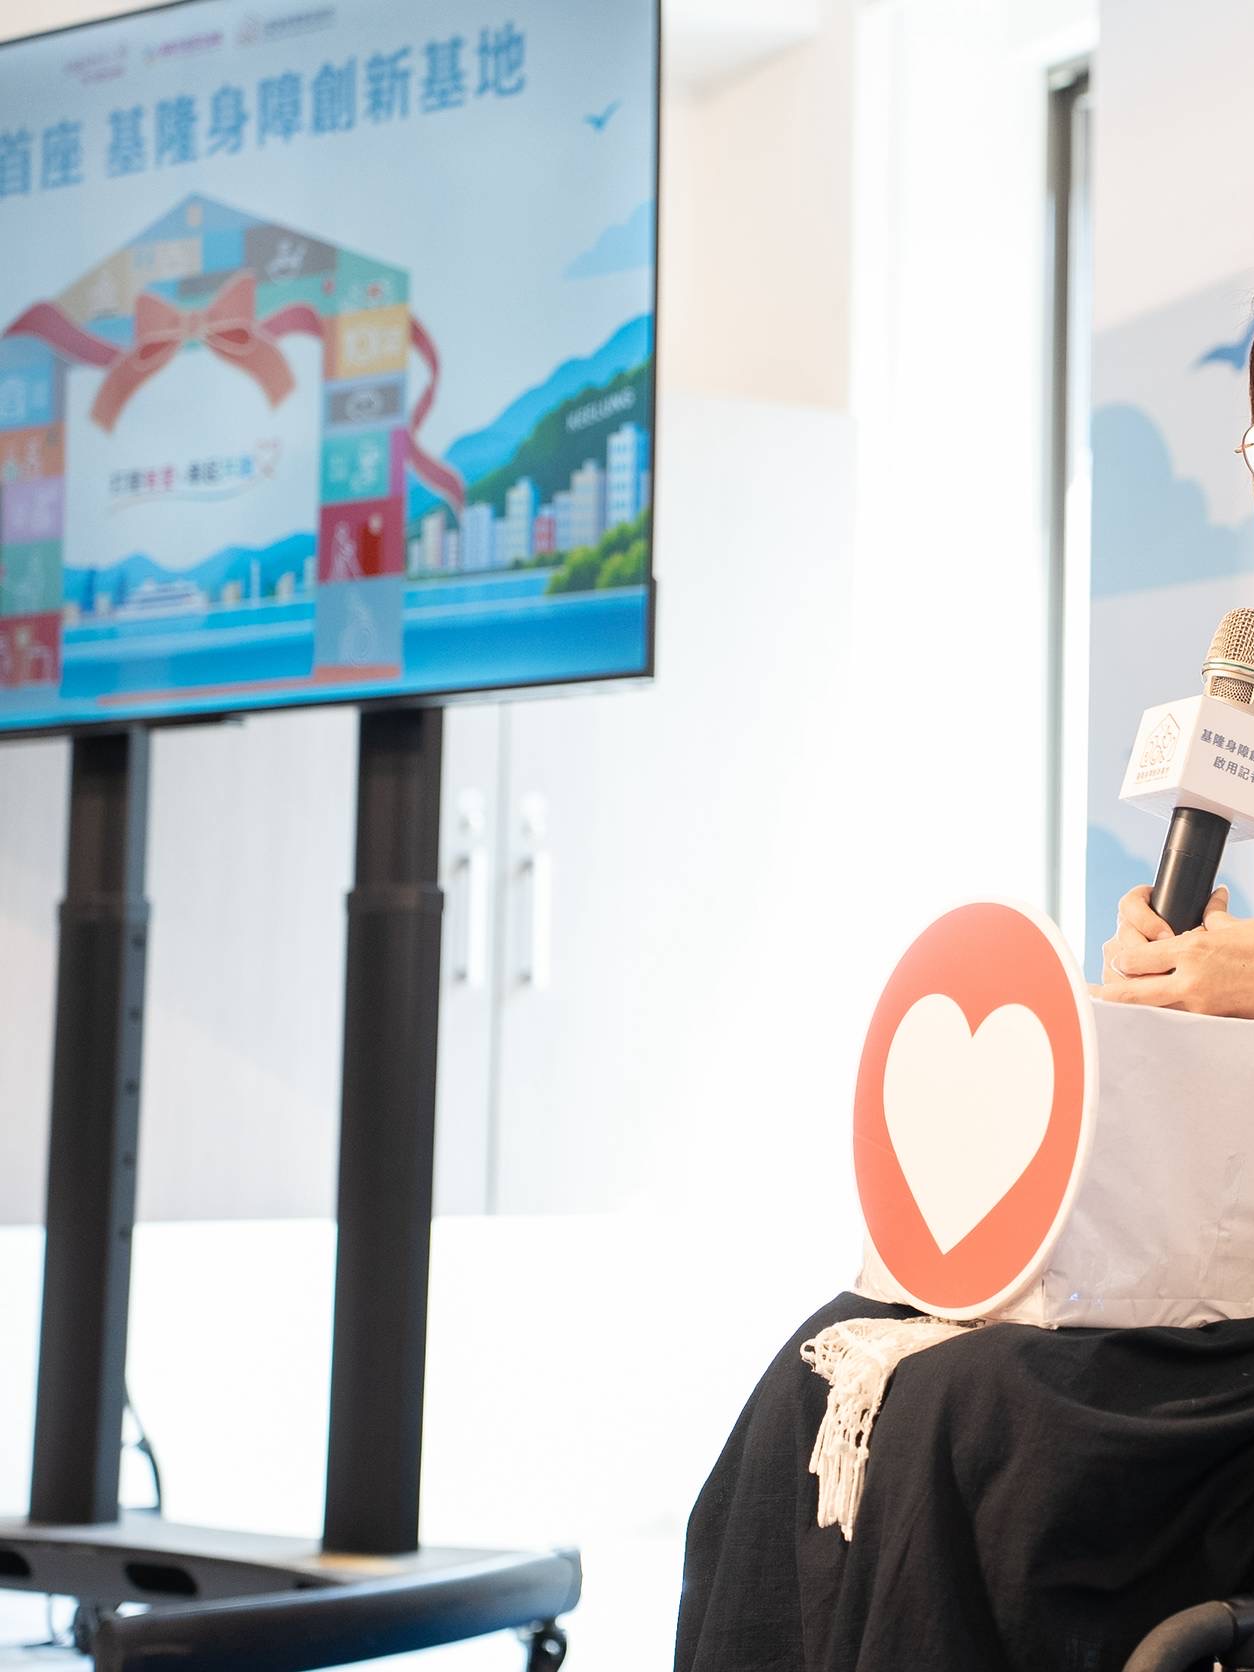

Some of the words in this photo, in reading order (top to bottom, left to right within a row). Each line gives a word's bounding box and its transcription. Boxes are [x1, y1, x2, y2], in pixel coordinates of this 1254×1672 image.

[106, 20, 527, 178] 基隆身障創新基地
